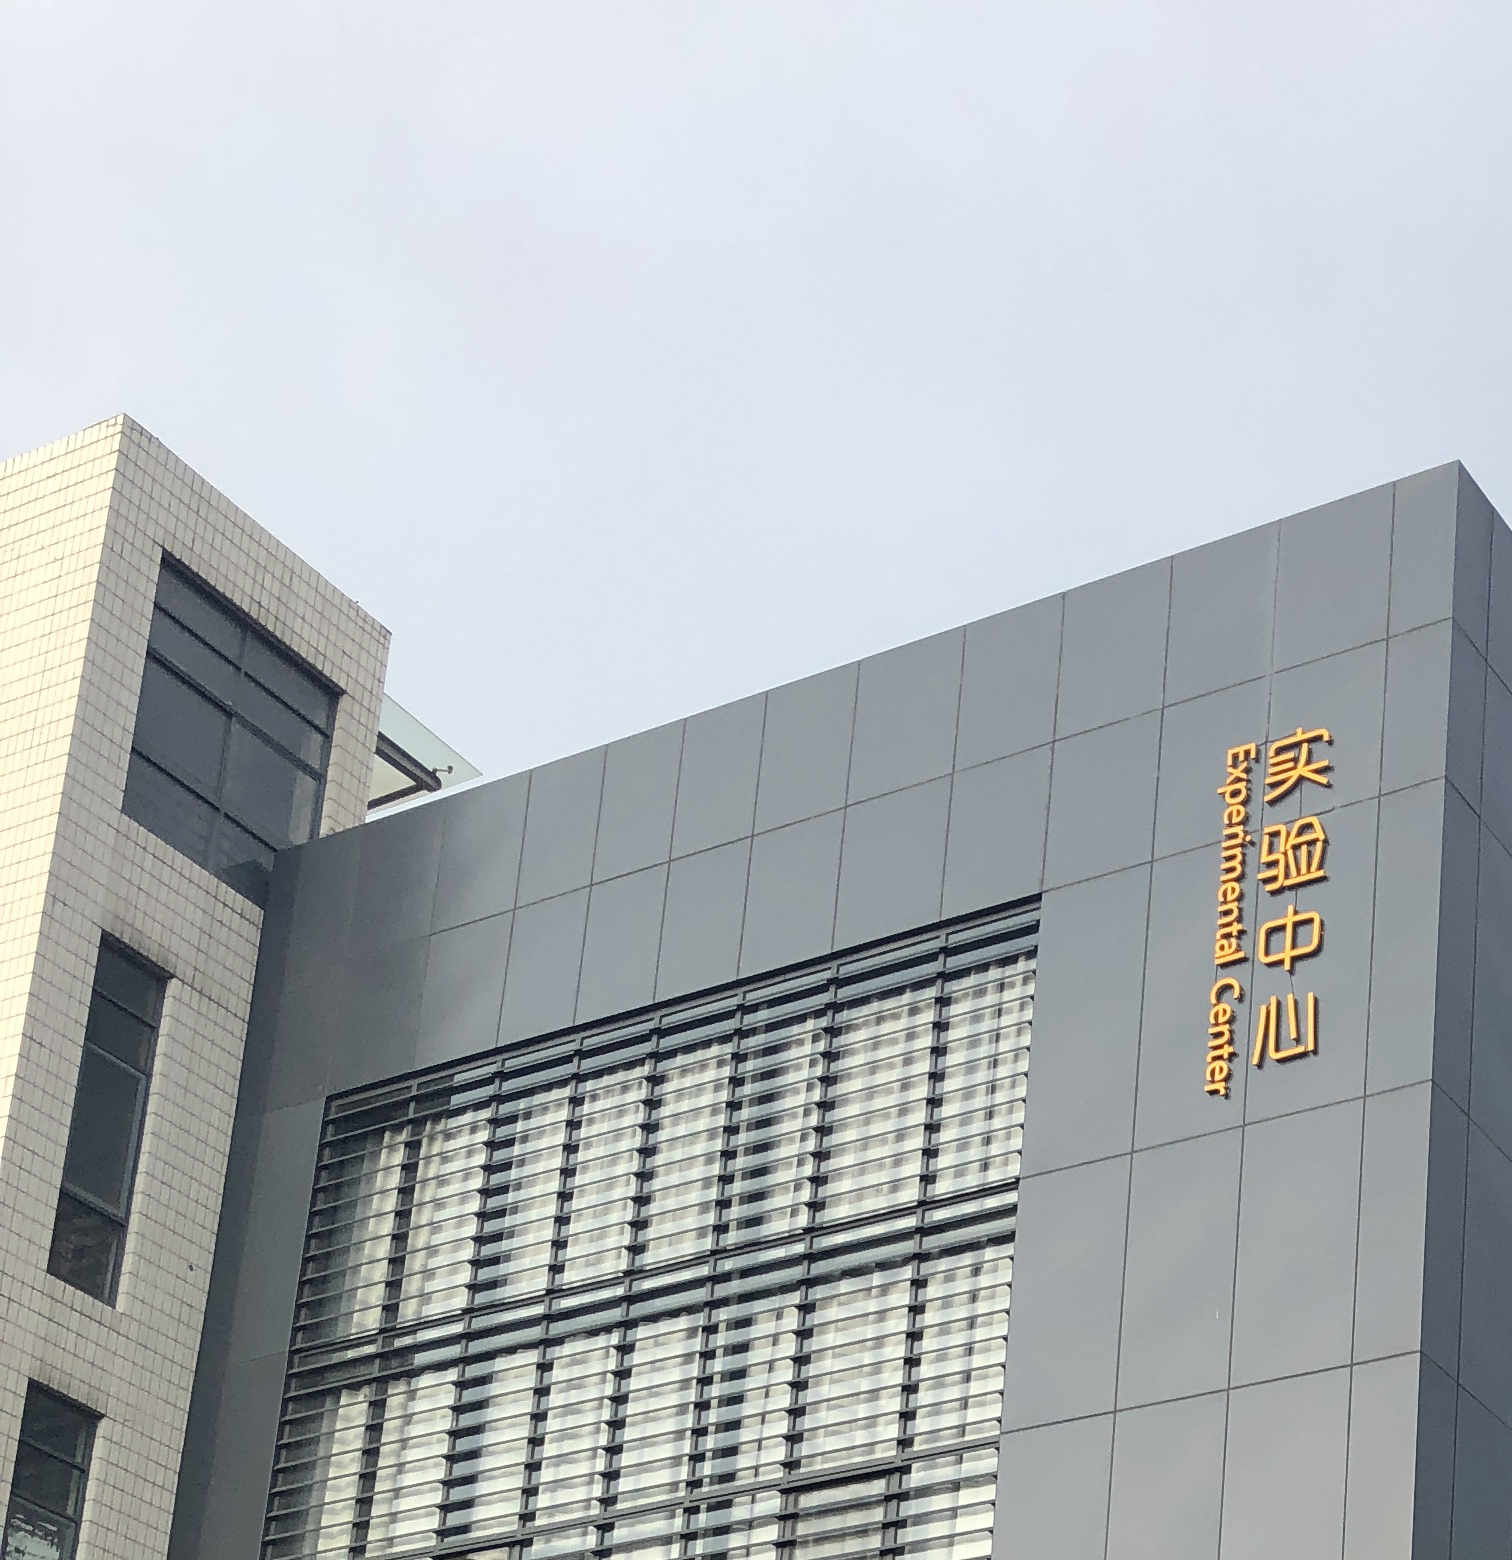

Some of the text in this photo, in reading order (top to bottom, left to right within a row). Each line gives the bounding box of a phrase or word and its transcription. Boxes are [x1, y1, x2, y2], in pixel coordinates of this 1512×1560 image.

[1204, 742, 1256, 1096] Experimental Center
[1252, 727, 1334, 1066] 实验中心
